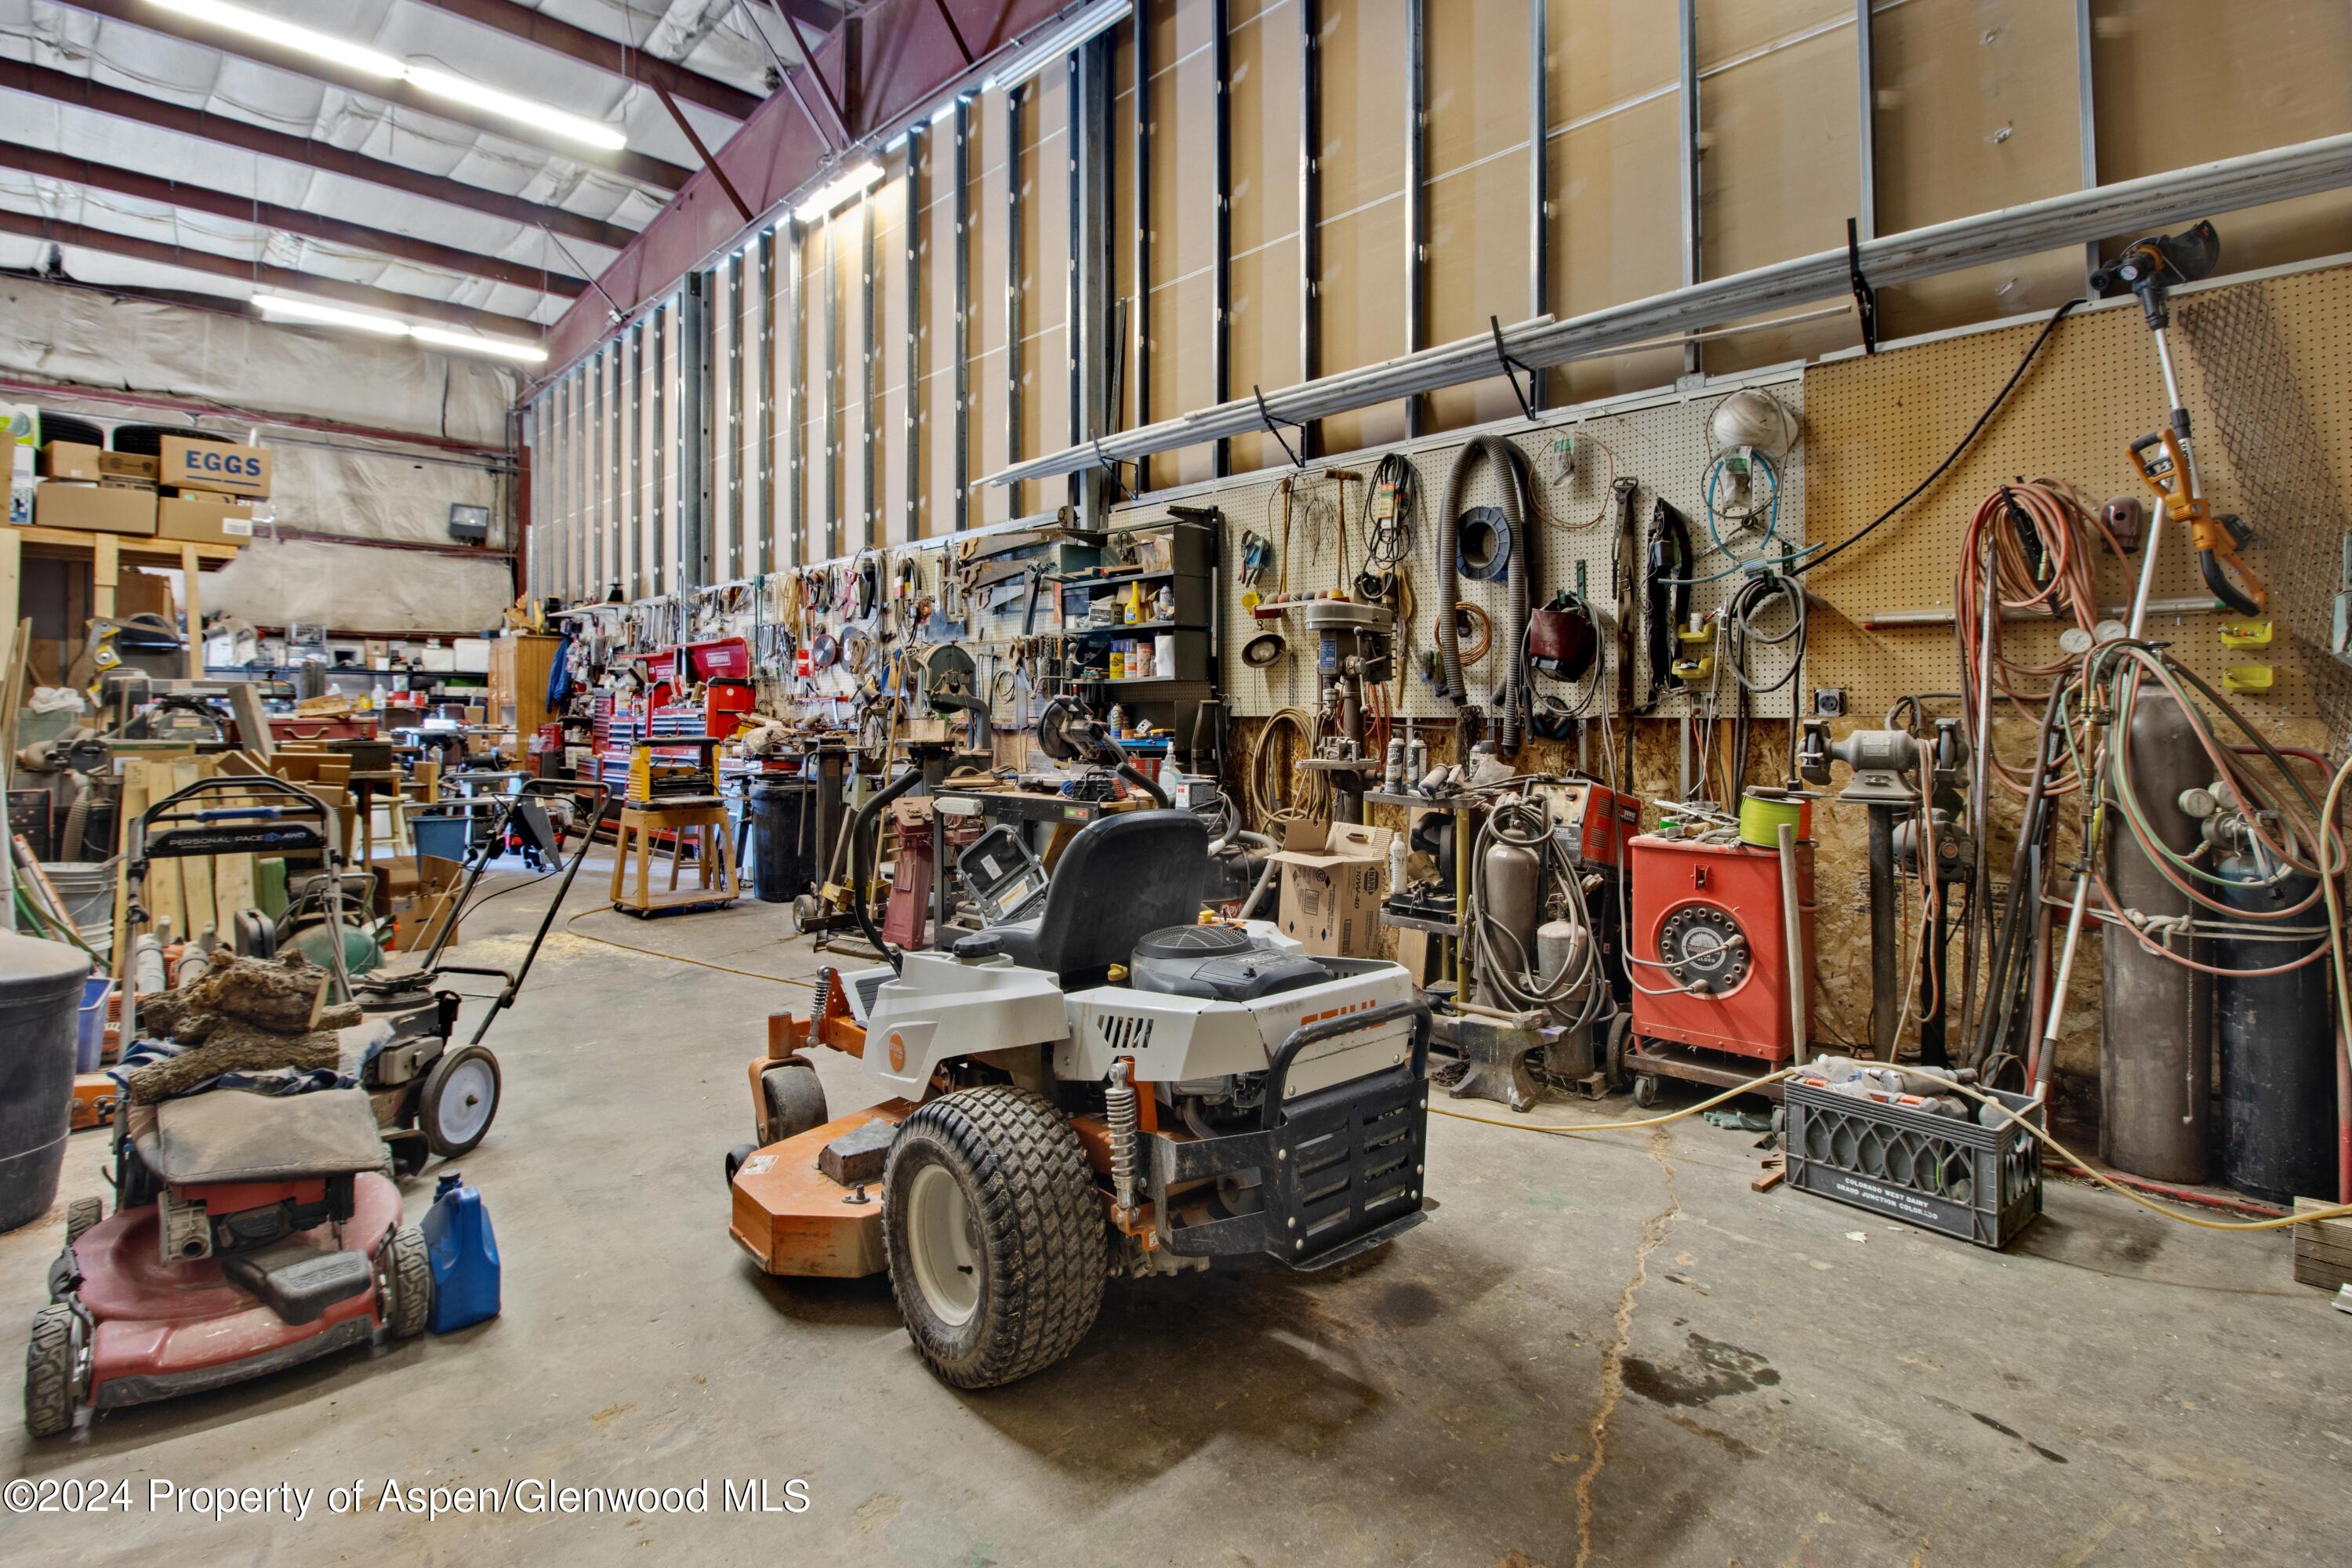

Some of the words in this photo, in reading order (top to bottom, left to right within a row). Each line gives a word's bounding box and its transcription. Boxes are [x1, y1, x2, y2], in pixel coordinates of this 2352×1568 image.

[185, 449, 262, 477] EGGS
[169, 837, 231, 846] PERSONAL
[281, 831, 307, 840] AWD
[1367, 870, 1376, 892] NAPA
[1836, 1183, 1860, 1195] GRAND
[1861, 1191, 1896, 1207] JUNCTION
[1845, 1178, 1882, 1194] COLORADO
[1885, 1189, 1905, 1201] WEST
[1906, 1196, 1929, 1208] DAIRY
